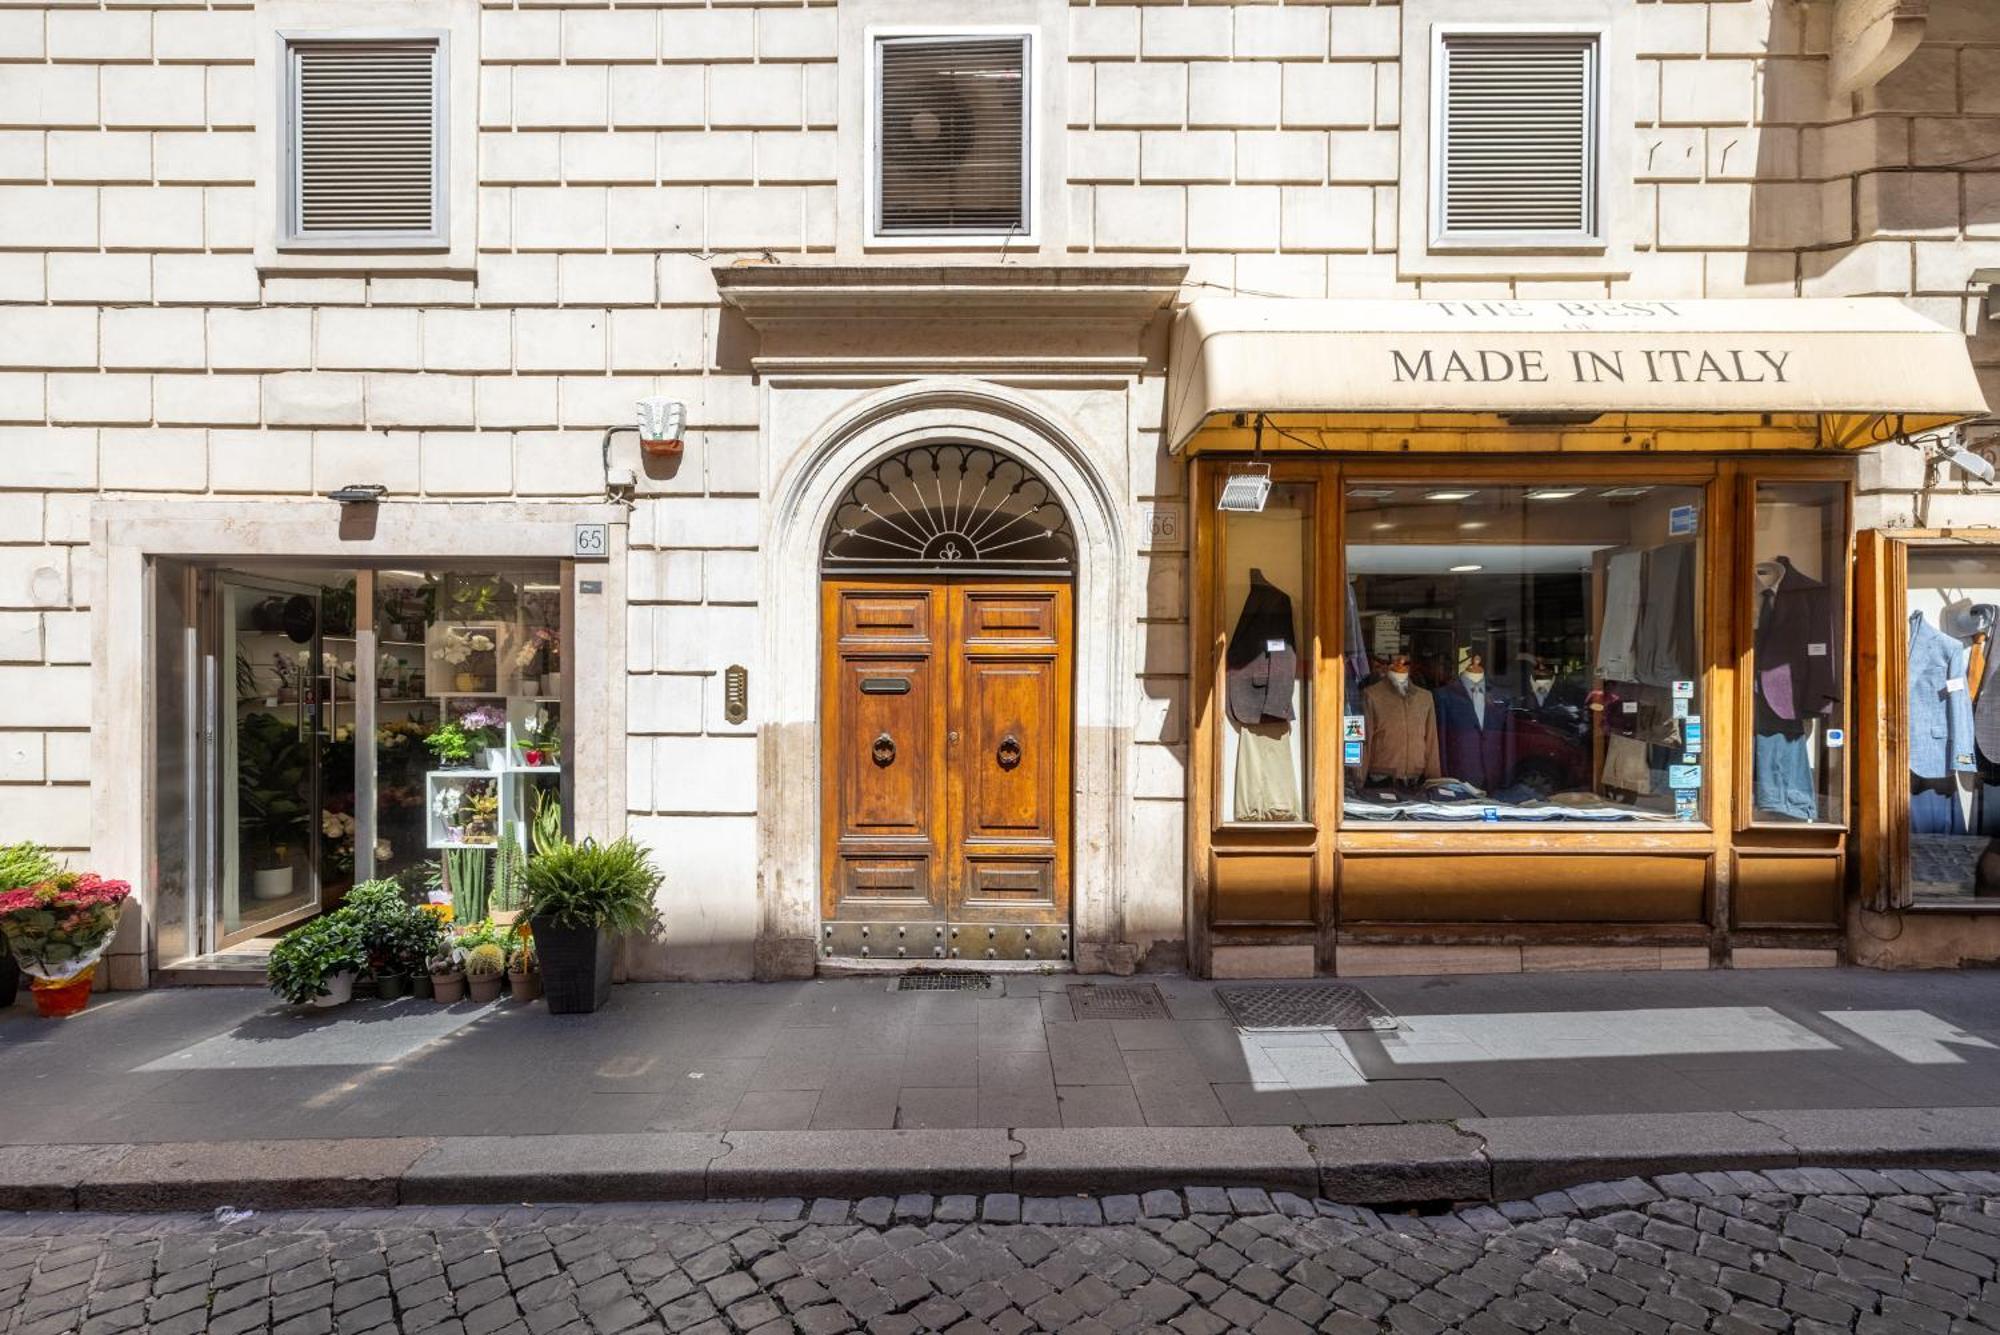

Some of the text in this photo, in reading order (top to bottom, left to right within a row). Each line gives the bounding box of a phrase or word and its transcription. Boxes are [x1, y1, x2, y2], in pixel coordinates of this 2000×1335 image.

[1426, 302, 1681, 317] THE BEST
[1389, 349, 1793, 384] MADE IN ITALY
[1149, 515, 1174, 536] 66
